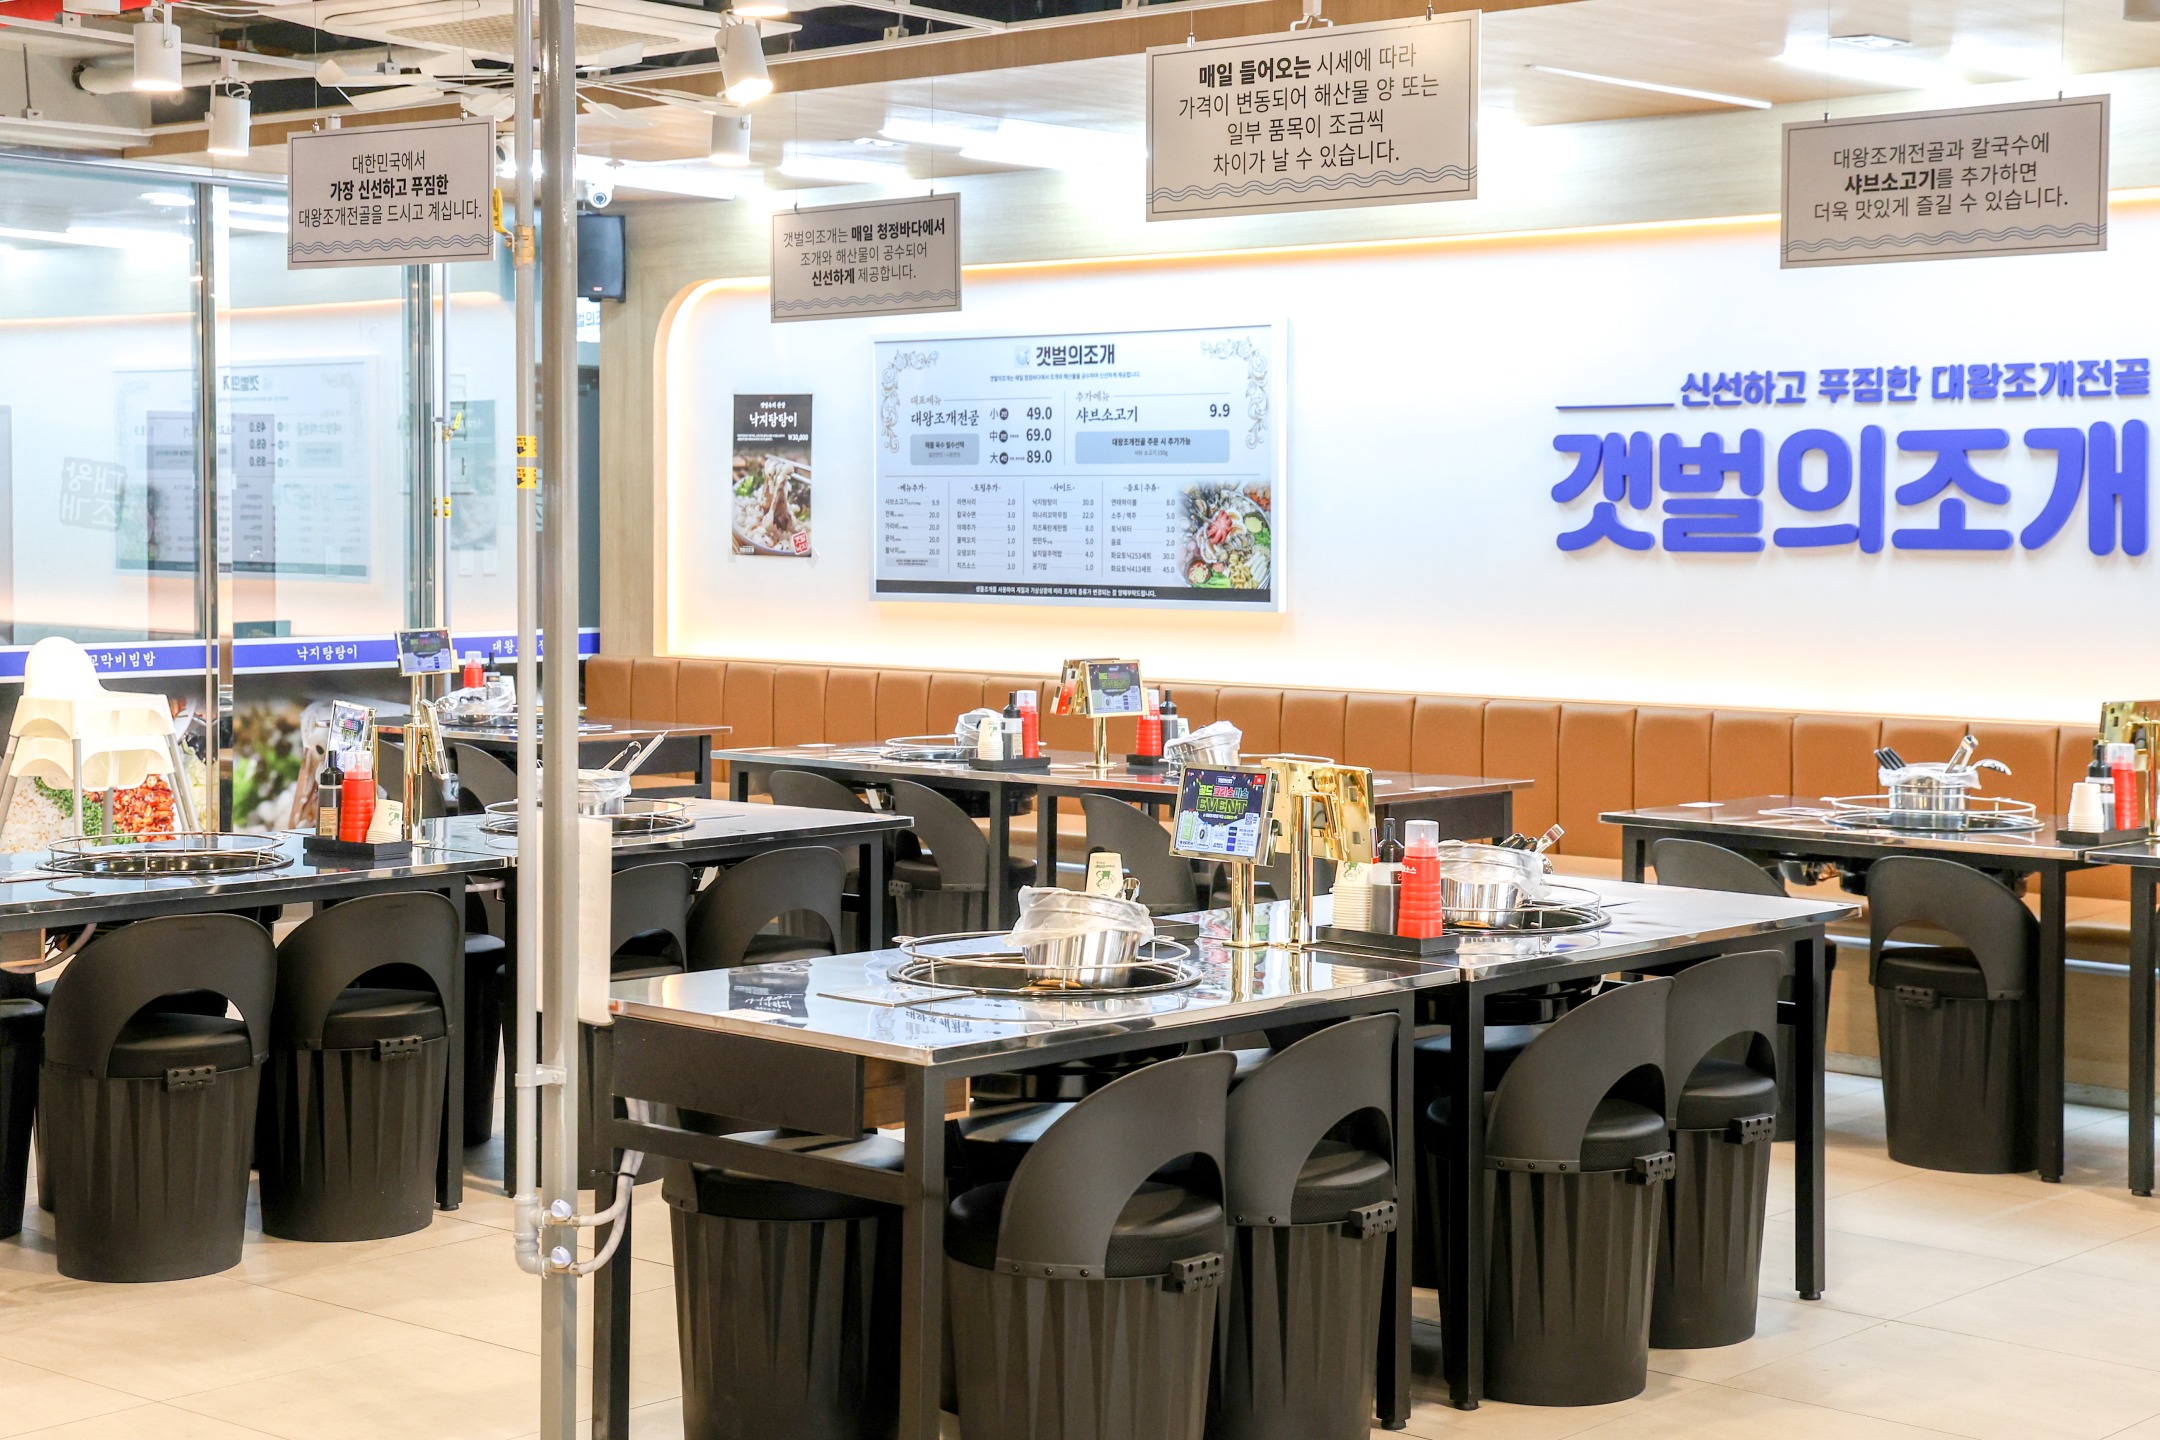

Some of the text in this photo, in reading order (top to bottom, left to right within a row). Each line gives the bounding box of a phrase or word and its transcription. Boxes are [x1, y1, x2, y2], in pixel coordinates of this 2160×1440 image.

[1199, 43, 1416, 88] 매일 들어오는 시세에 따라
[1178, 73, 1439, 120] 가격이 변동되어 해산물 양 또는
[1228, 109, 1384, 146] 일부 품목이 조금씩
[352, 150, 425, 174] 대한민국에서
[1213, 138, 1399, 176] 차이가 날 수 있습니다.
[1834, 131, 2049, 170] 대왕조개전골과 칼국수에
[330, 174, 448, 201] 가장 신선하고 푸짐한
[1844, 161, 2037, 195] 샤브소고기를 추가하면
[299, 204, 383, 228] 대왕조개전골을
[387, 203, 423, 223] 드시고
[428, 199, 482, 221] 계십니다.
[1815, 185, 2068, 223] 더욱 맛있게 즐길 수 있습니다.
[783, 218, 945, 248] 갯벌의조개는 매일 청정바다에서
[800, 242, 927, 267] 조개와 해산물이 공수되어
[812, 264, 916, 287] 신선하게 제공합니다.
[1035, 343, 1115, 367] 갯벌의조개
[1681, 358, 2150, 408] 신선하고 푸짐한 대왕조개전골
[911, 394, 942, 406] 대표메뉴
[1076, 390, 1110, 402] 추가메뉴
[749, 411, 797, 428] 낙지탕탕이
[911, 409, 980, 427] 대왕조개전골
[989, 407, 998, 420] 小
[1026, 406, 1052, 420] 49.0
[1076, 403, 1230, 423] 샤브소고기 9.9
[989, 429, 998, 443] 中
[1026, 428, 1052, 442] 69.0
[1112, 437, 1191, 446] 대왕조개전골 주문 시 추가가능
[989, 452, 998, 464] 大
[1026, 450, 1052, 463] 89.0
[1551, 419, 2149, 556] 갯벌의조개
[296, 644, 357, 661] 낙지탕탕이
[1196, 796, 1248, 814] EVENT
